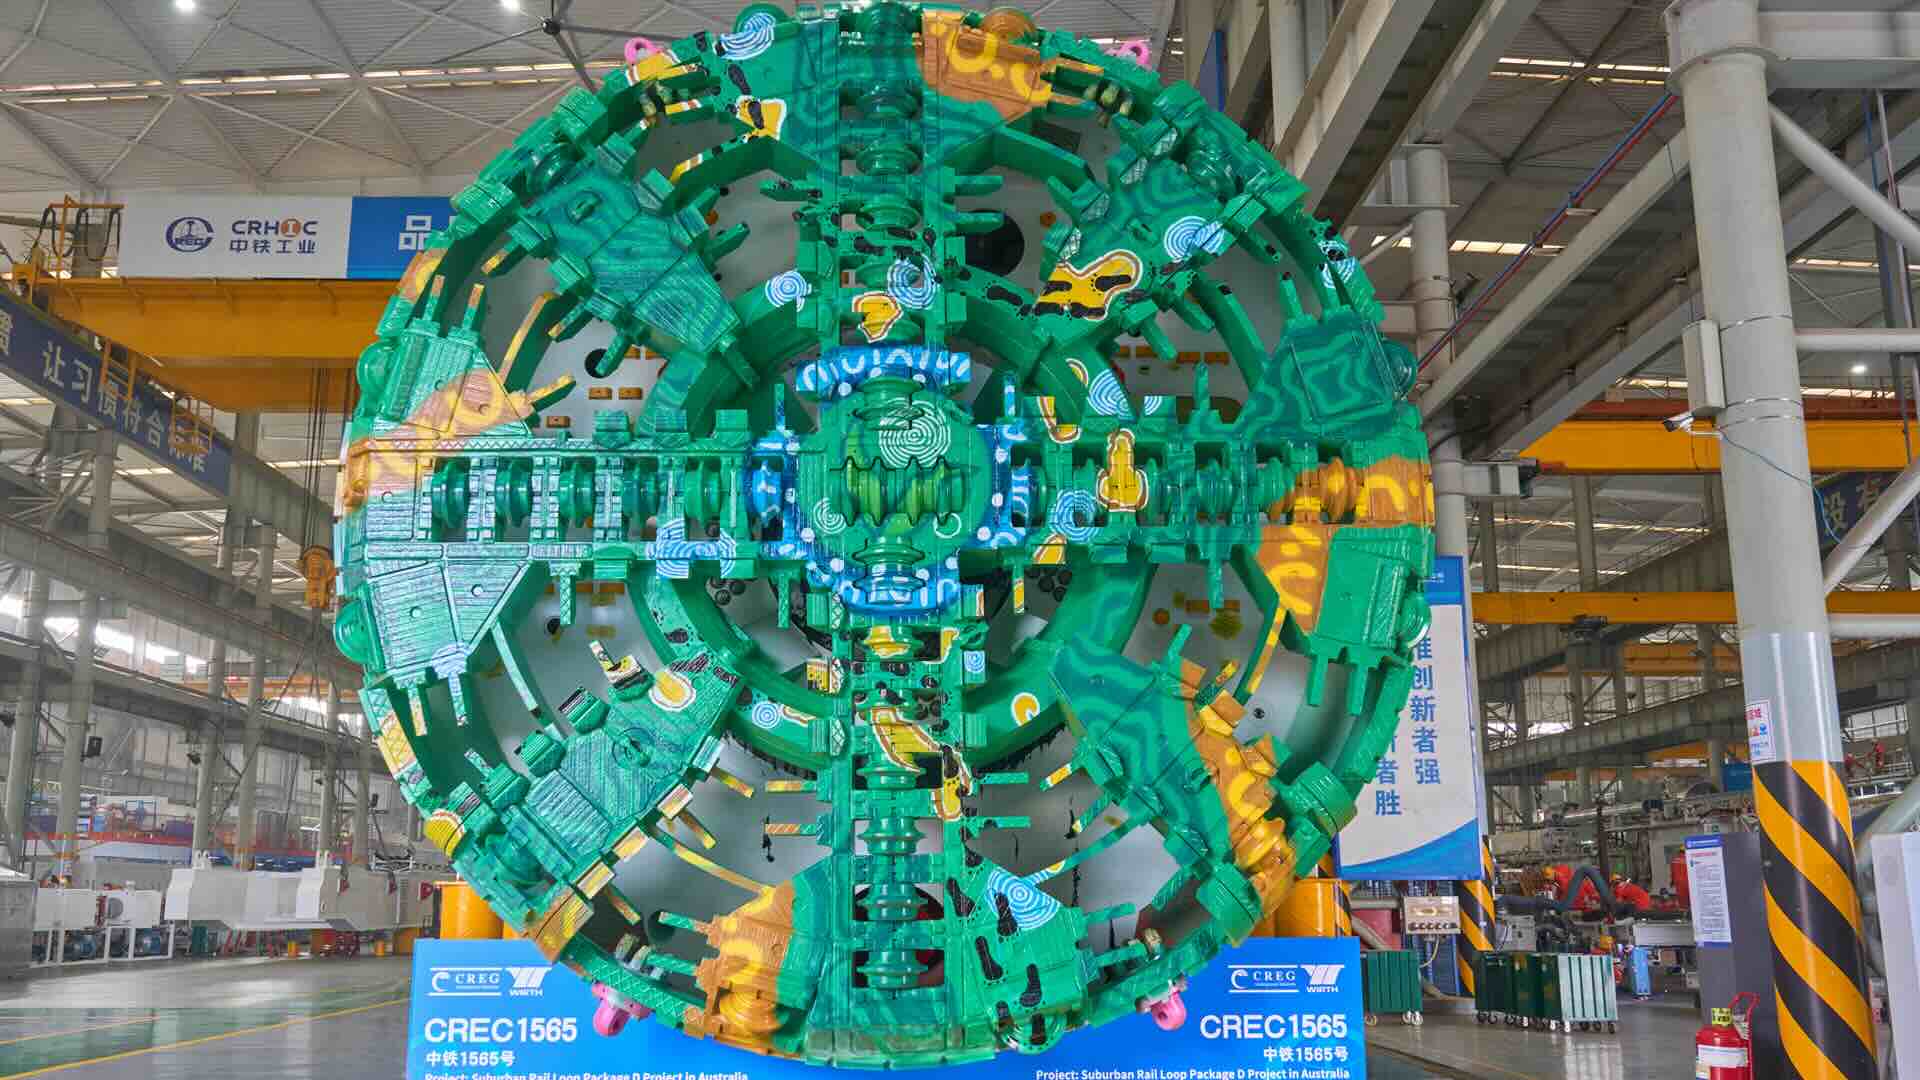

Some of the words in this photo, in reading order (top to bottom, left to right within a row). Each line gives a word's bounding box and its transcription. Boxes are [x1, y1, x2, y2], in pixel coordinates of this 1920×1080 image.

[229, 239, 316, 254] 中铁工业
[1376, 736, 1401, 816] 者胜
[455, 972, 500, 985] CREG
[1253, 970, 1296, 981] CREG
[424, 1017, 577, 1042] CREC1565
[1200, 1014, 1347, 1039] CREC1565
[426, 1050, 515, 1067] 中铁1565号
[1263, 1046, 1348, 1062] 中铁1565号
[1036, 1070, 1079, 1080] Project:
[1082, 1070, 1134, 1080] Suburban
[1137, 1069, 1158, 1080] Rail
[1161, 1070, 1187, 1080] Loop
[1189, 1069, 1235, 1080] Package
[1237, 1069, 1245, 1079] D
[1248, 1069, 1286, 1080] Project
[1288, 1069, 1299, 1079] in
[1301, 1069, 1350, 1079] Australia
